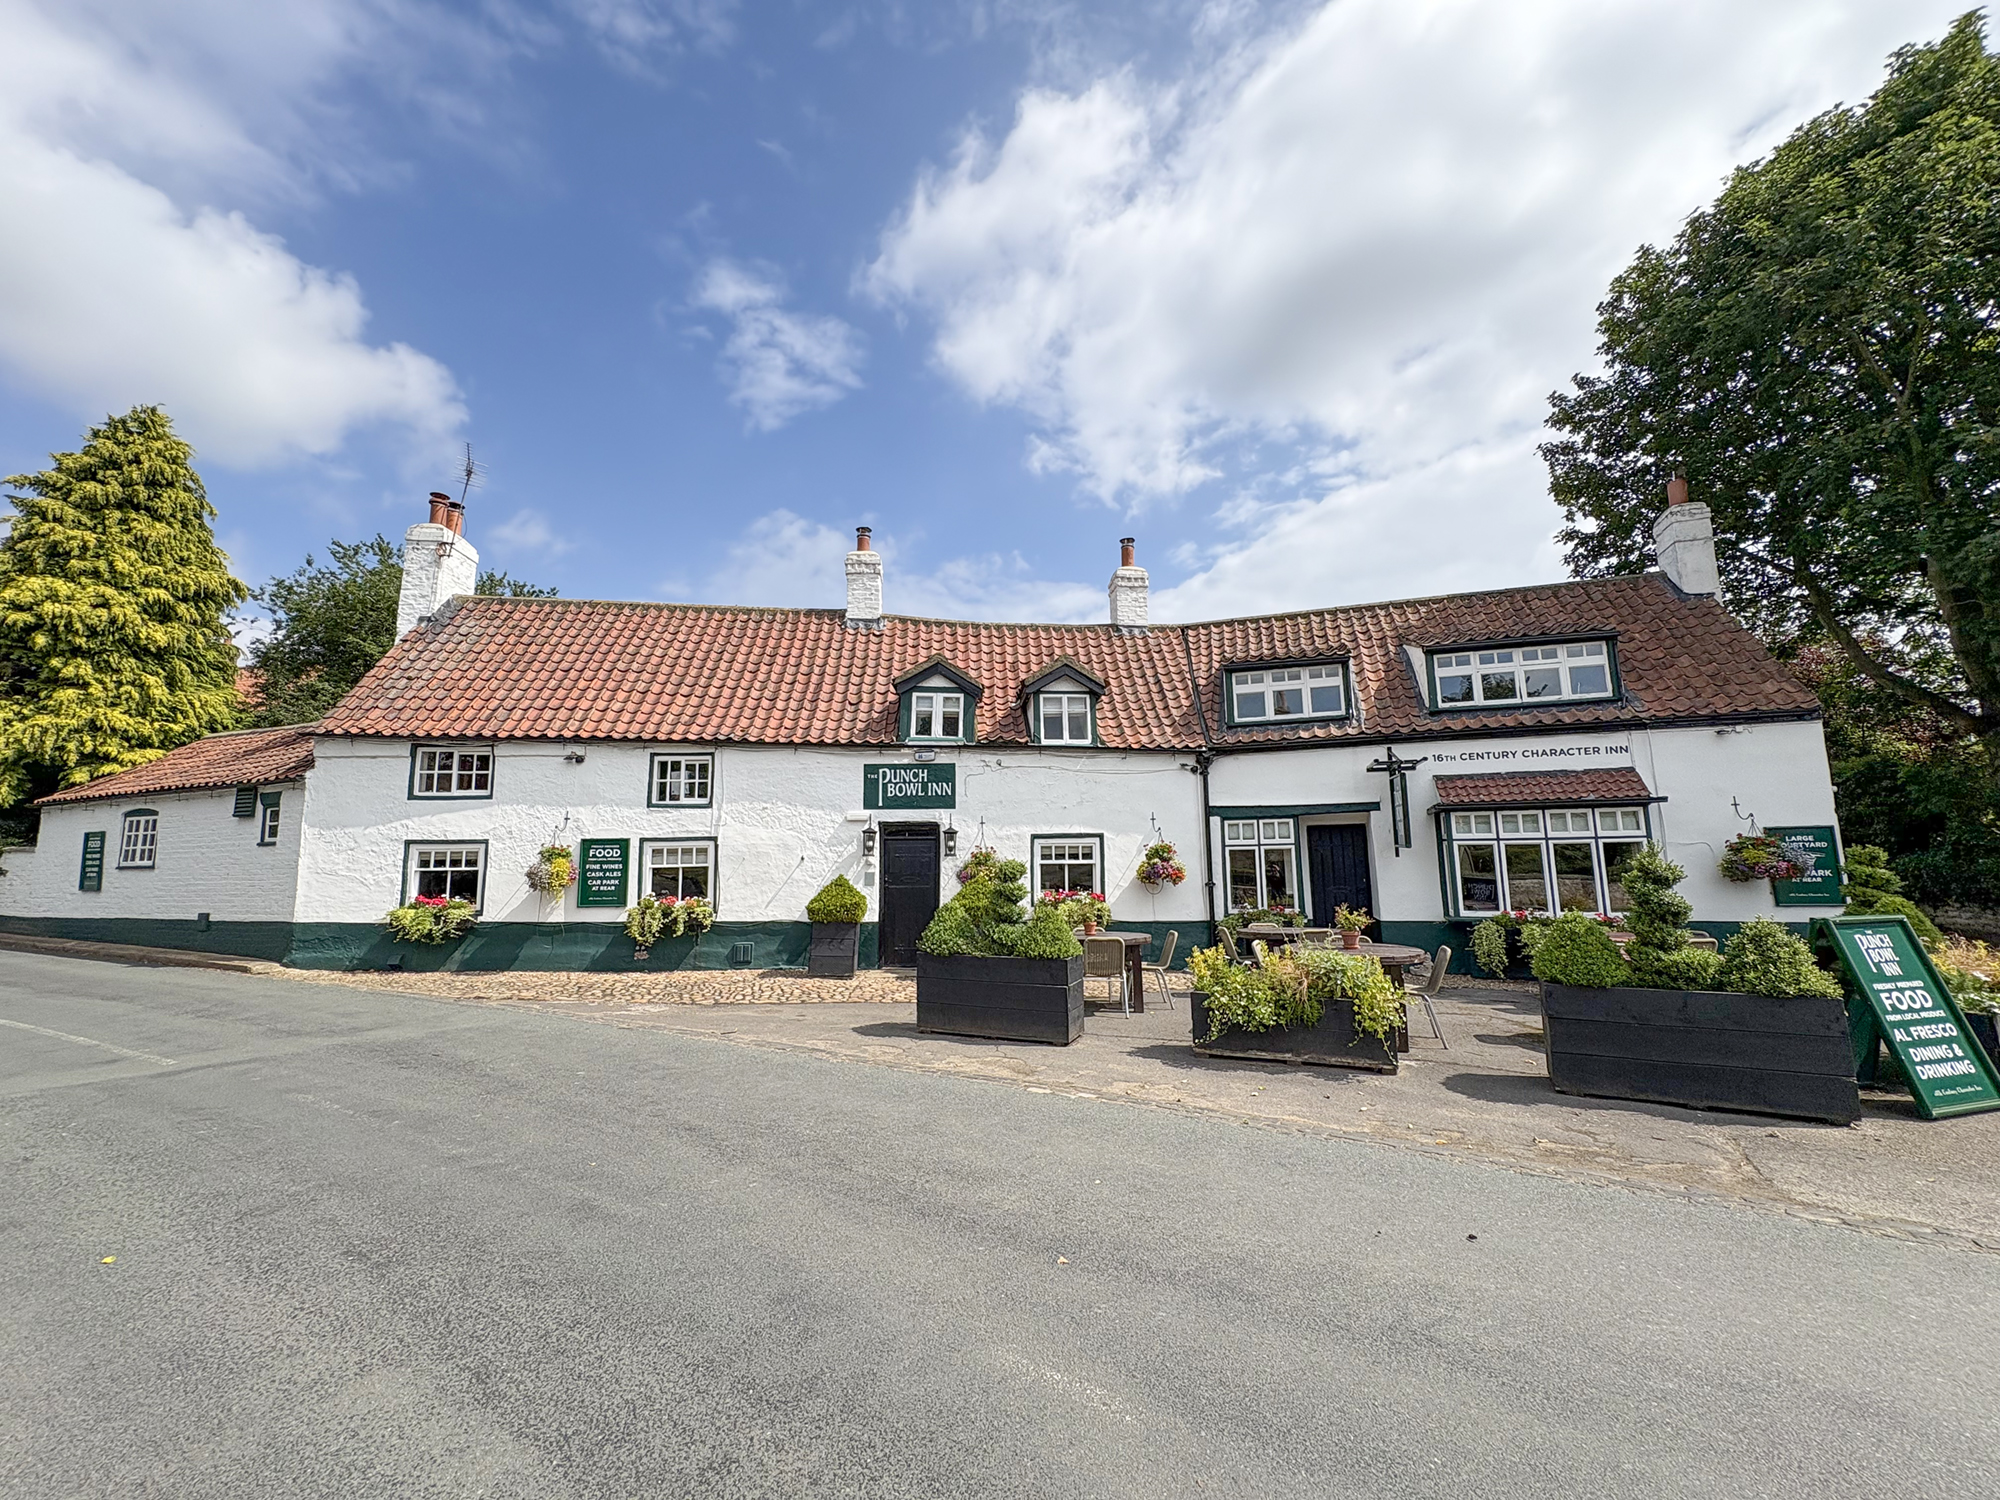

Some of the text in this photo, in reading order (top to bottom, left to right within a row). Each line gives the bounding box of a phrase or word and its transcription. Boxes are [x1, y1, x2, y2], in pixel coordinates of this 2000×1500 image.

[1459, 750, 1518, 761] CENTURY
[1521, 746, 1601, 758] CHARACTER
[1605, 745, 1629, 755] INN
[878, 768, 928, 807] PUNCH
[887, 782, 952, 797] BOWL INN
[589, 849, 621, 857] FOOD
[1853, 934, 1894, 973] PUNCH
[1868, 948, 1900, 962] BOWL
[1880, 962, 1904, 976] INN
[1880, 989, 1933, 1011] FOOD
[1885, 1014, 1903, 1022] FROM
[1902, 1012, 1921, 1020] LOCAL
[1893, 1023, 1958, 1042] AL FRESCO
[1908, 1043, 1964, 1062] DINING &
[1915, 1060, 1976, 1080] DRINKING
